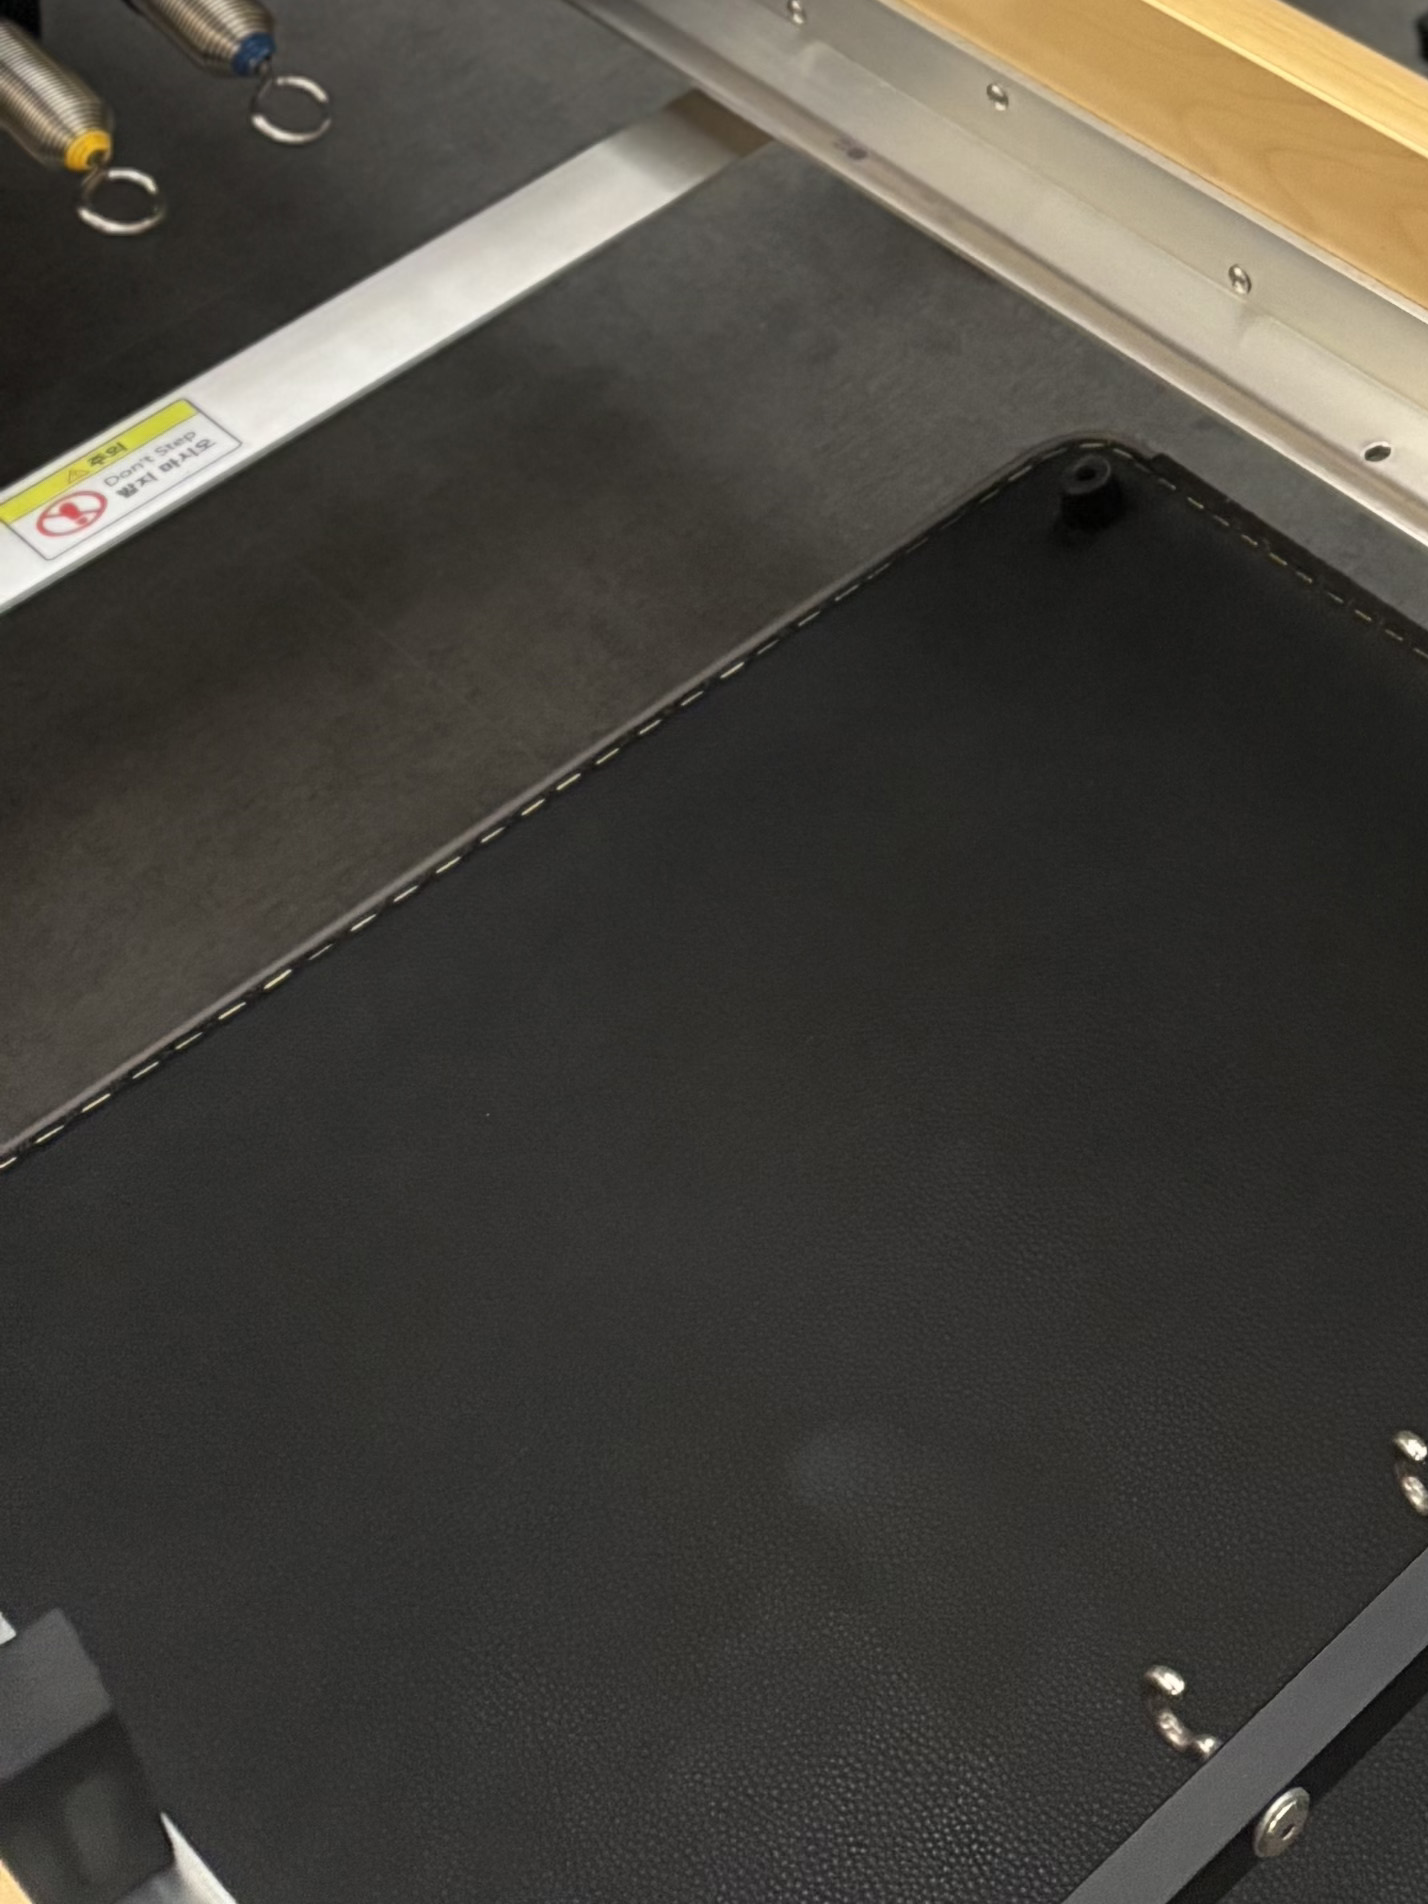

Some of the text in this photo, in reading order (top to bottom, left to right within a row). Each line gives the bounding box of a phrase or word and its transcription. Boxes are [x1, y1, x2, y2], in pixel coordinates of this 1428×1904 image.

[88, 442, 128, 467] 주의
[103, 431, 196, 487] Don't Step
[158, 439, 216, 472] 마시오
